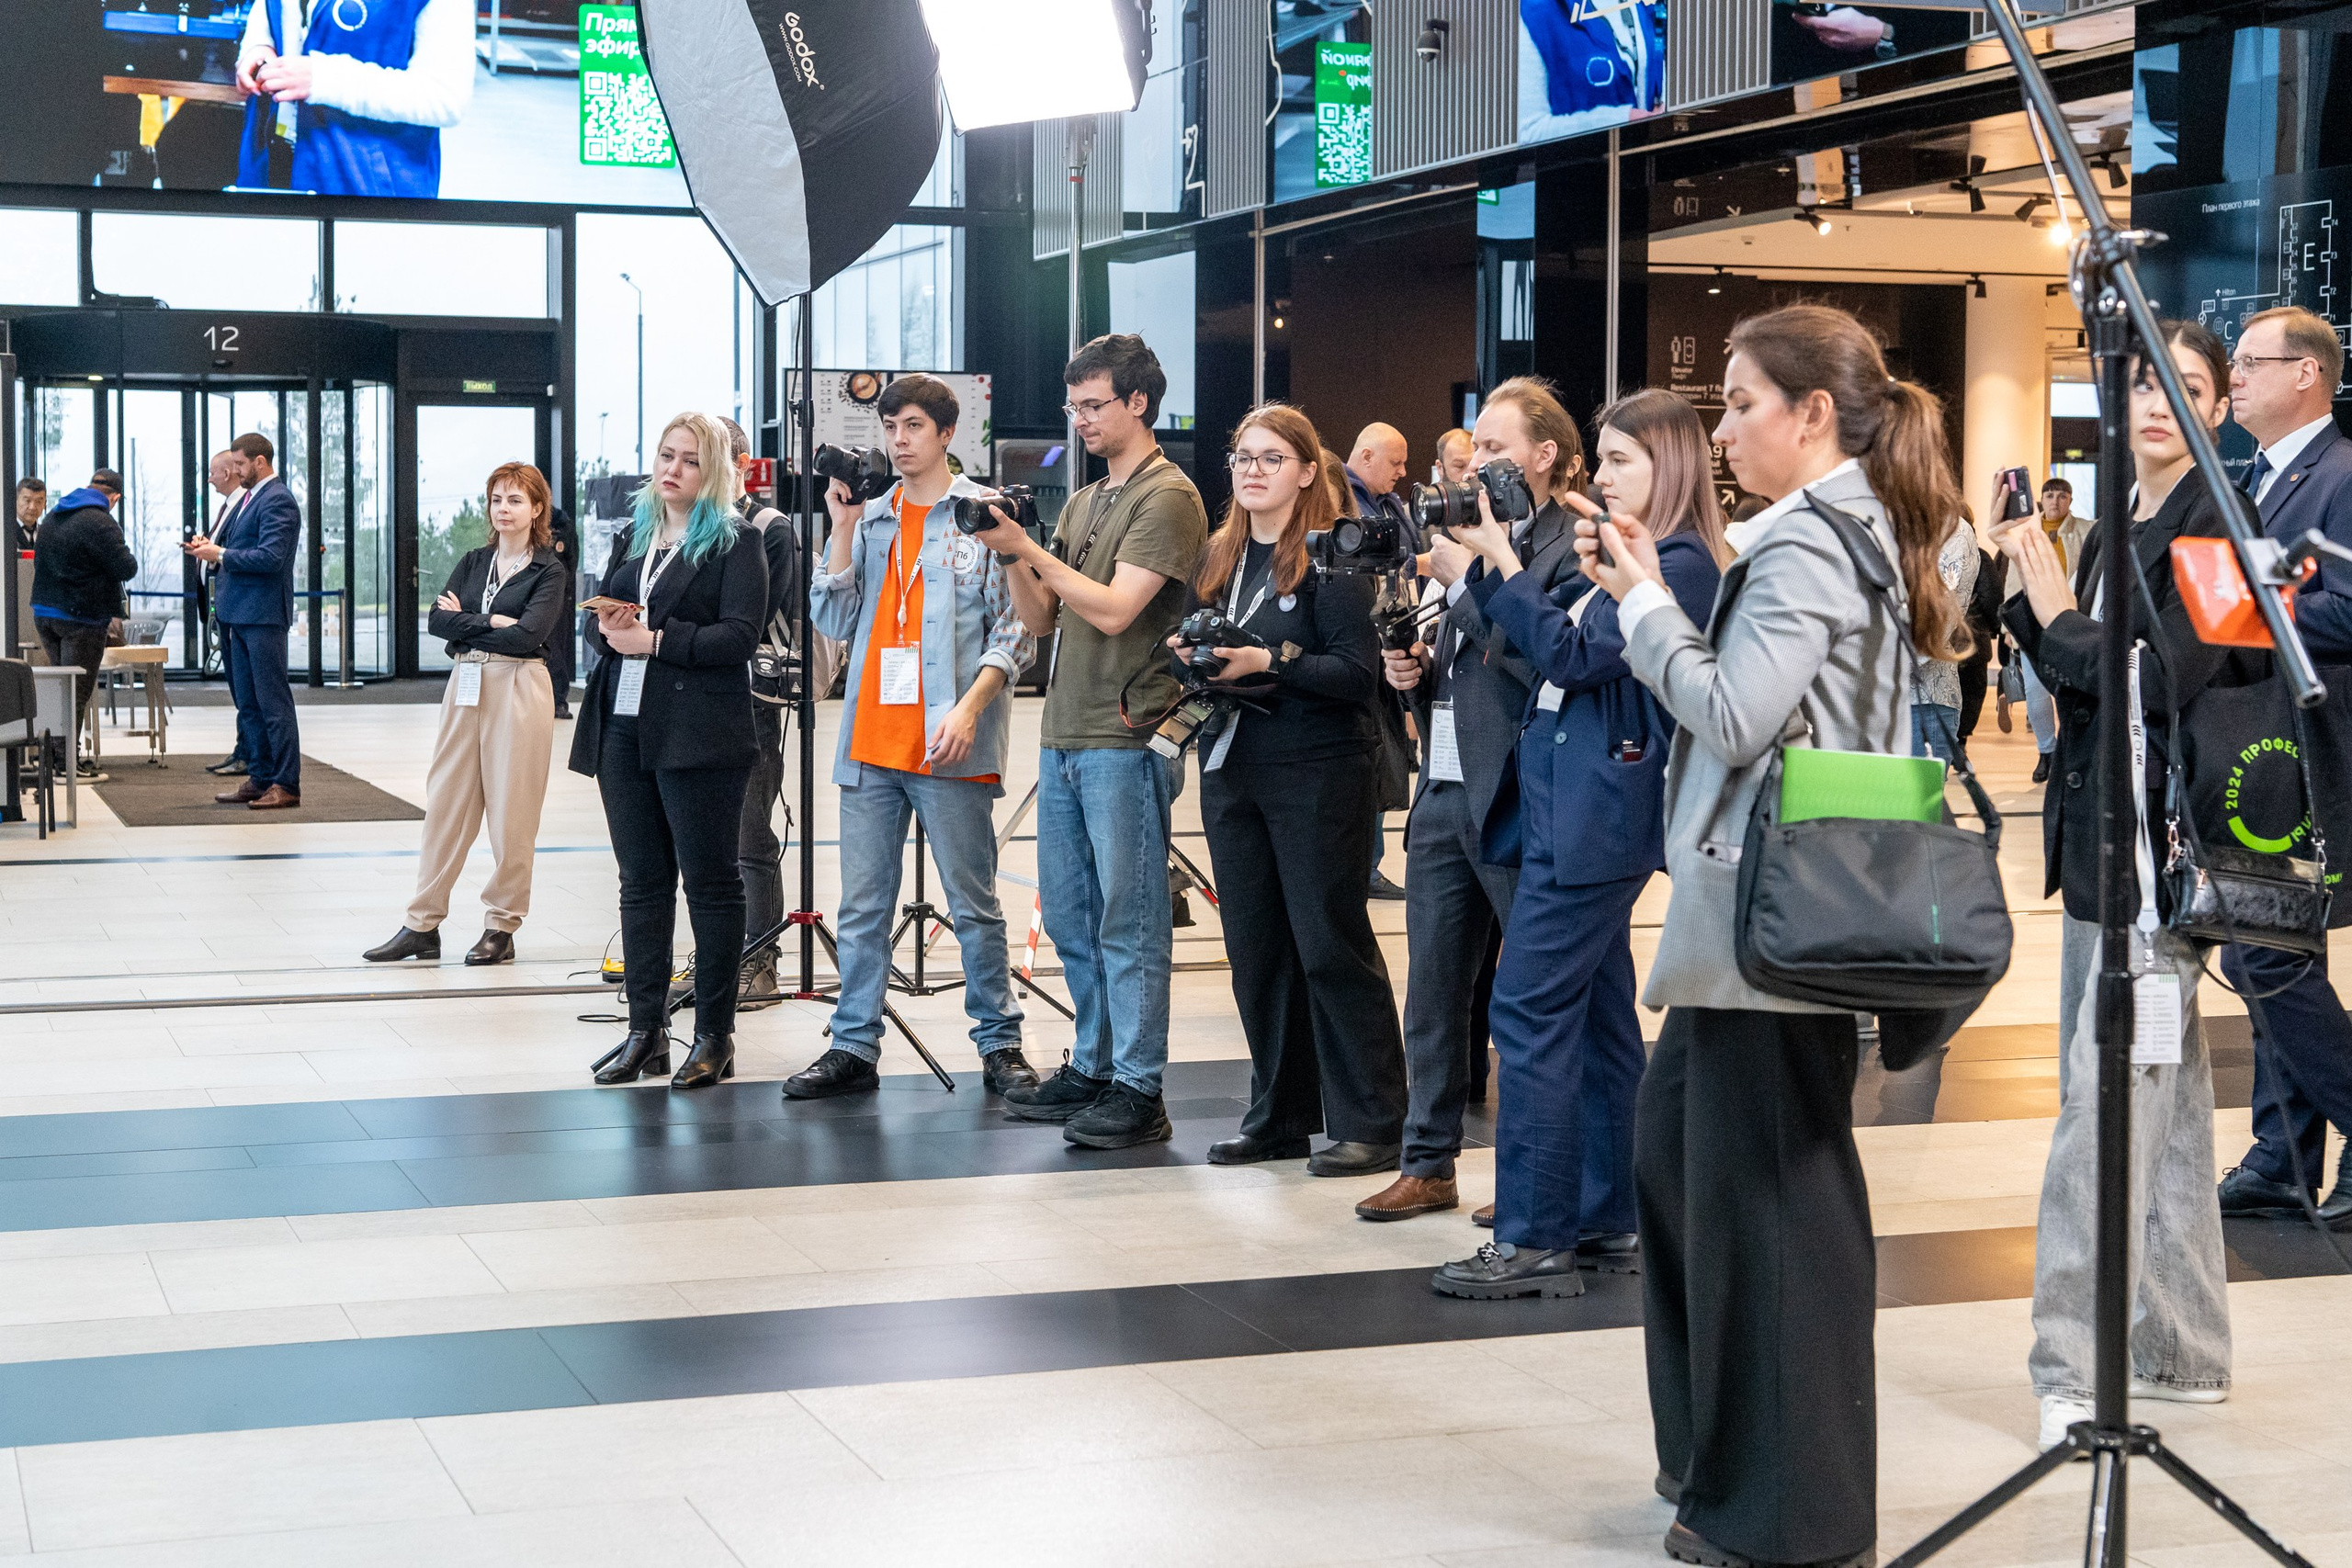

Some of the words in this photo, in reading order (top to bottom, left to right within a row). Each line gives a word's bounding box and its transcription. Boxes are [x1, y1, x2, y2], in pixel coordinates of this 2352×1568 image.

[584, 12, 638, 37] Прям
[778, 22, 802, 83] WWW.GODOX.COM
[785, 11, 820, 87] Godox
[2201, 203, 2218, 213] План
[2218, 200, 2243, 212] первого
[2303, 243, 2316, 271] E
[203, 325, 240, 351] 12
[956, 550, 968, 560] Пб
[2225, 766, 2244, 809] 2024
